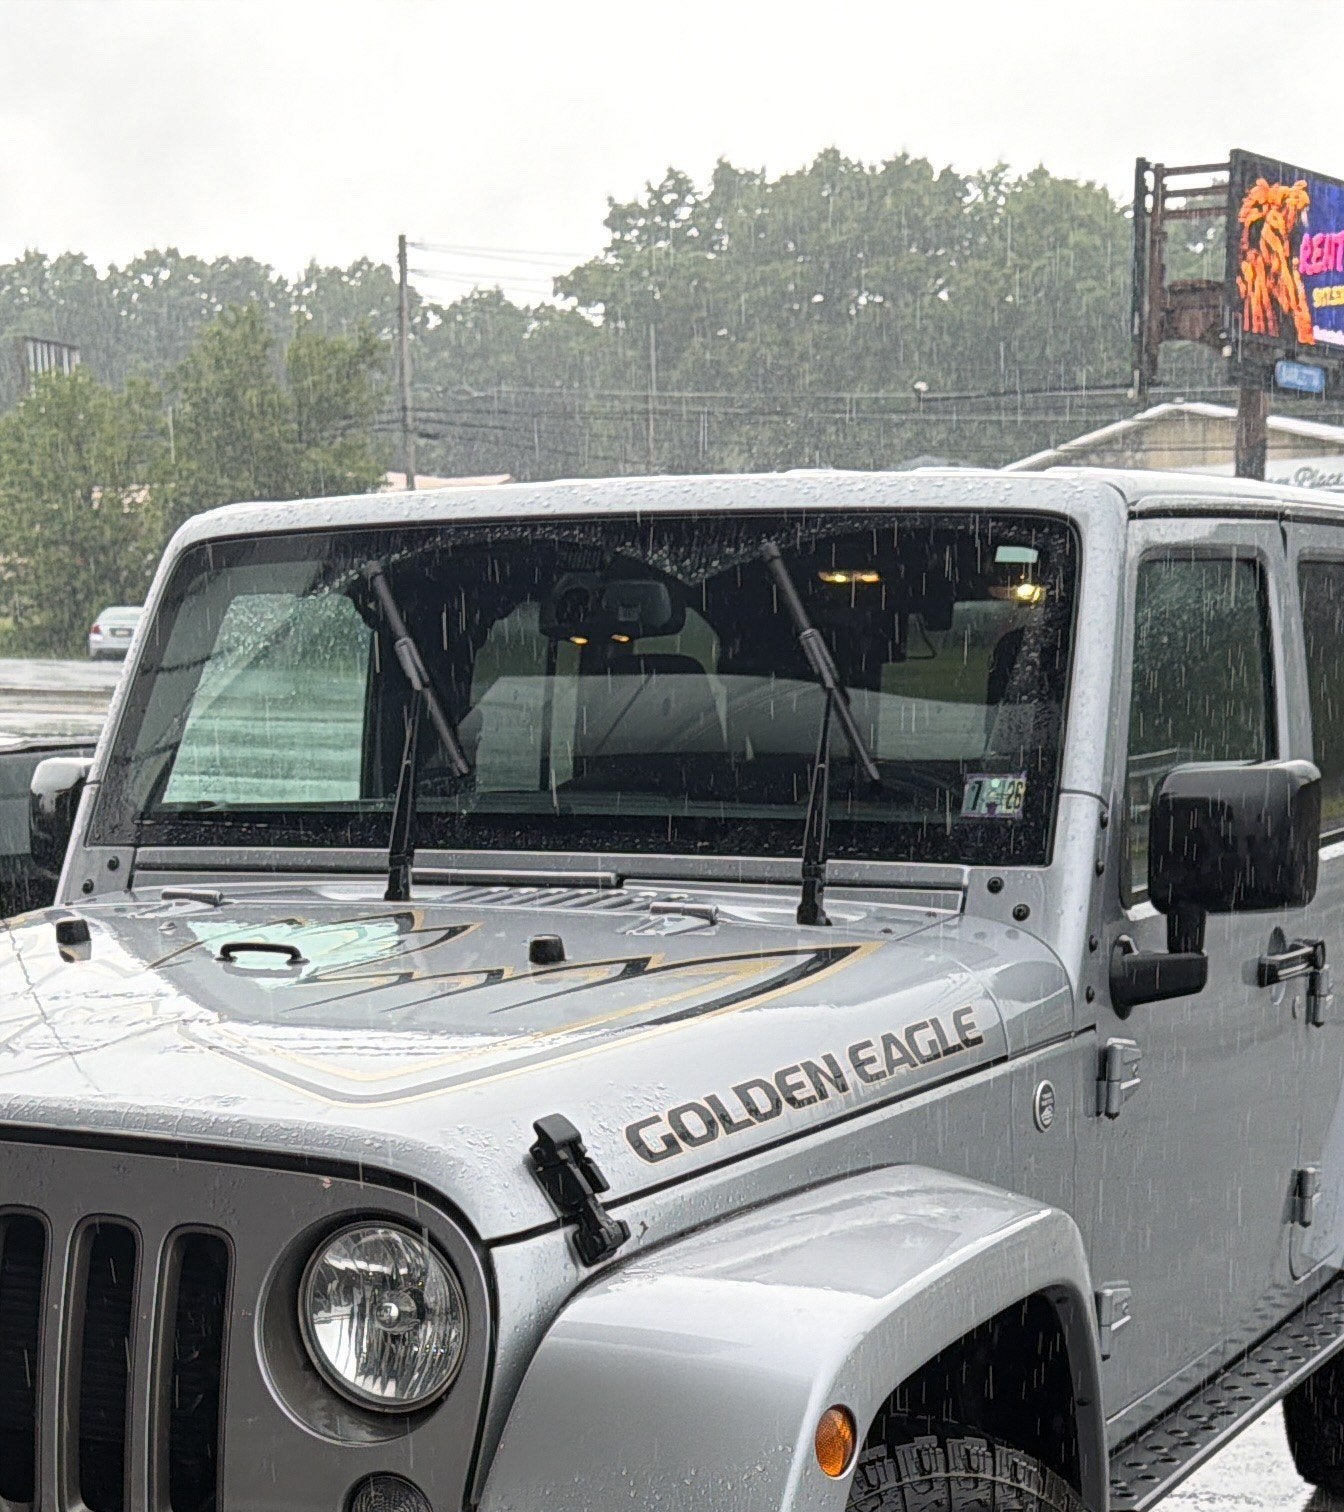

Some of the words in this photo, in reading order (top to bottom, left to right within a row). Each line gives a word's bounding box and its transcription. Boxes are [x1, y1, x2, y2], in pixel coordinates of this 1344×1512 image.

[969, 780, 983, 811] 7
[1005, 781, 1024, 810] 26
[624, 1052, 850, 1164] GOLDEN
[847, 1005, 986, 1084] EAGLE
